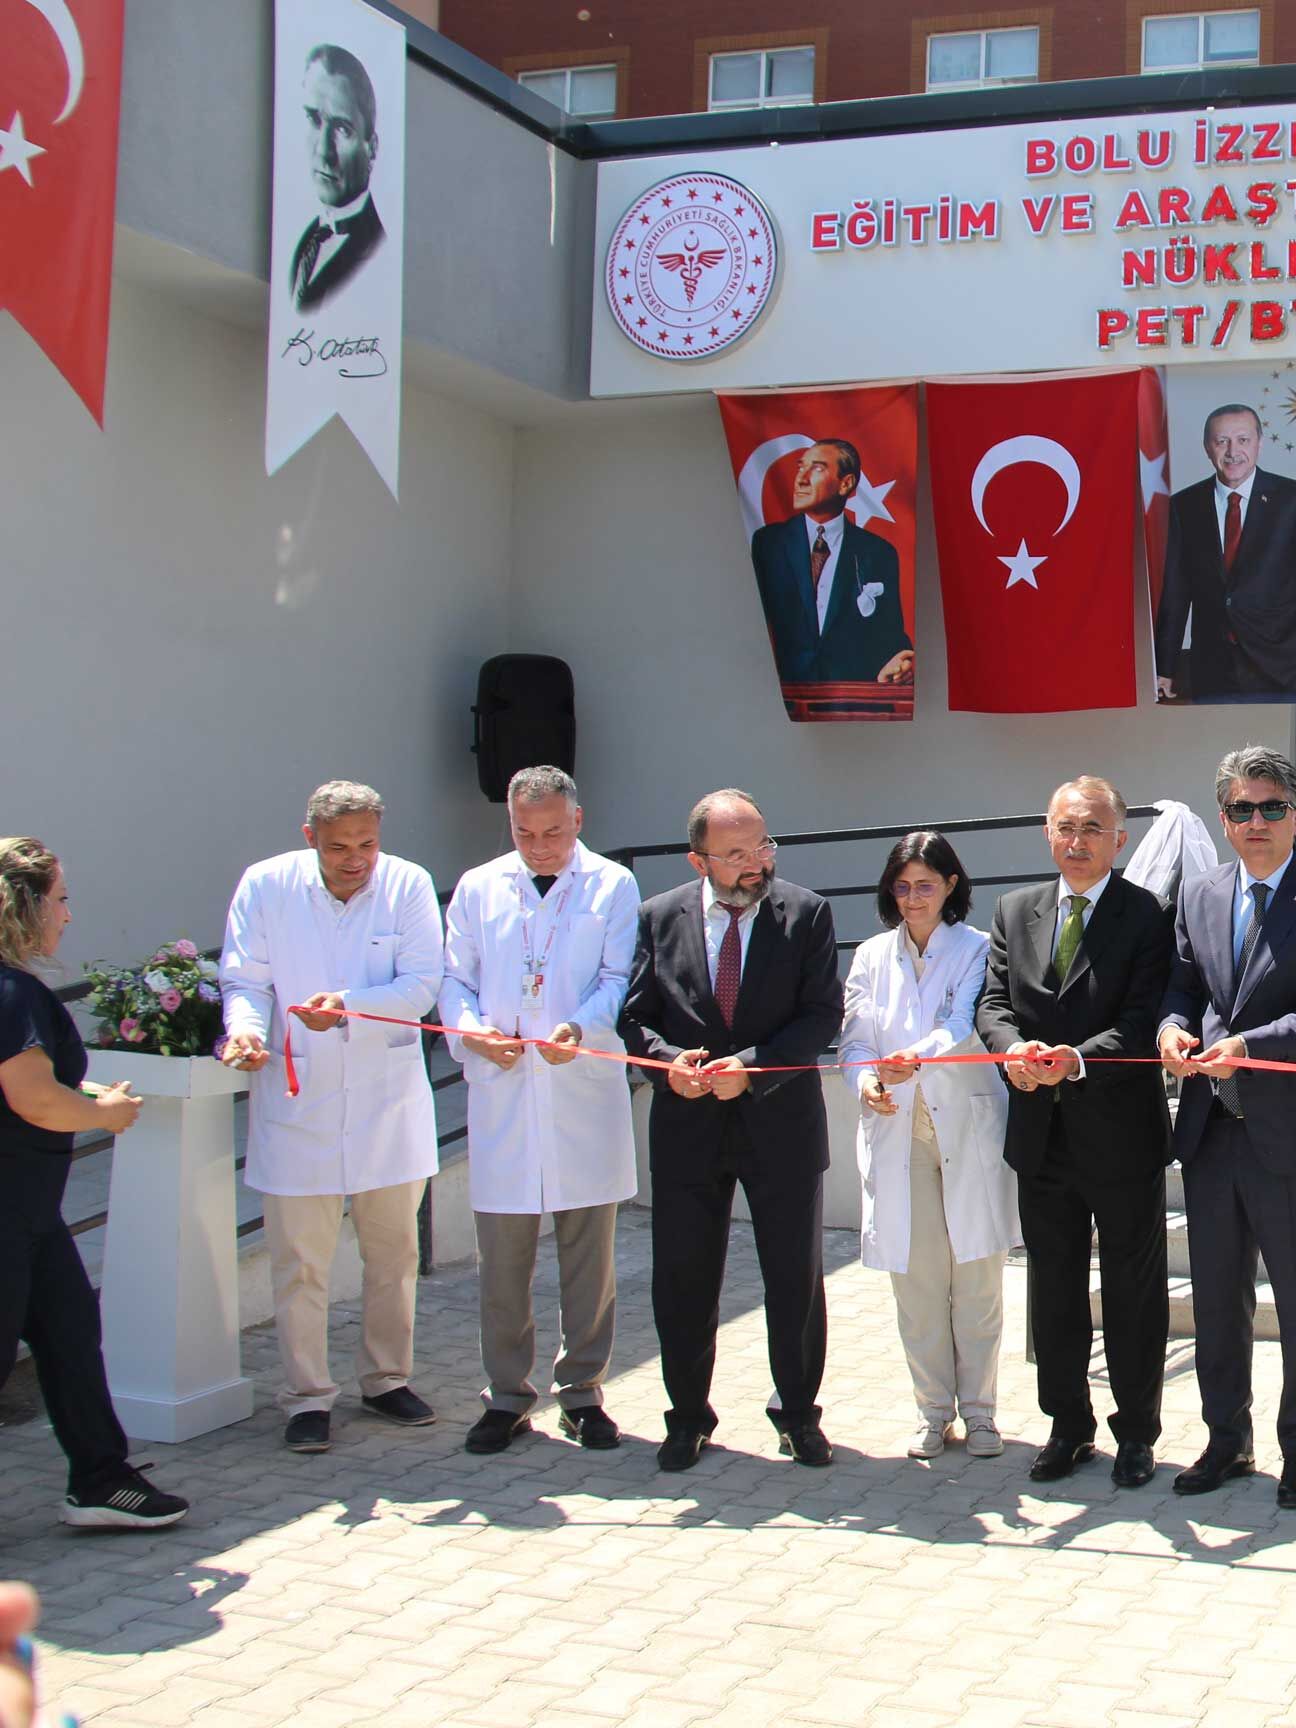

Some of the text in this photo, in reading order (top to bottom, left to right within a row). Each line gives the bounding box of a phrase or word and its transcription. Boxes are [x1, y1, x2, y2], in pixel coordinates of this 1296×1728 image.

[1026, 129, 1173, 176] BOLU
[810, 194, 999, 251] EĞİTİM
[1021, 192, 1093, 234] VE
